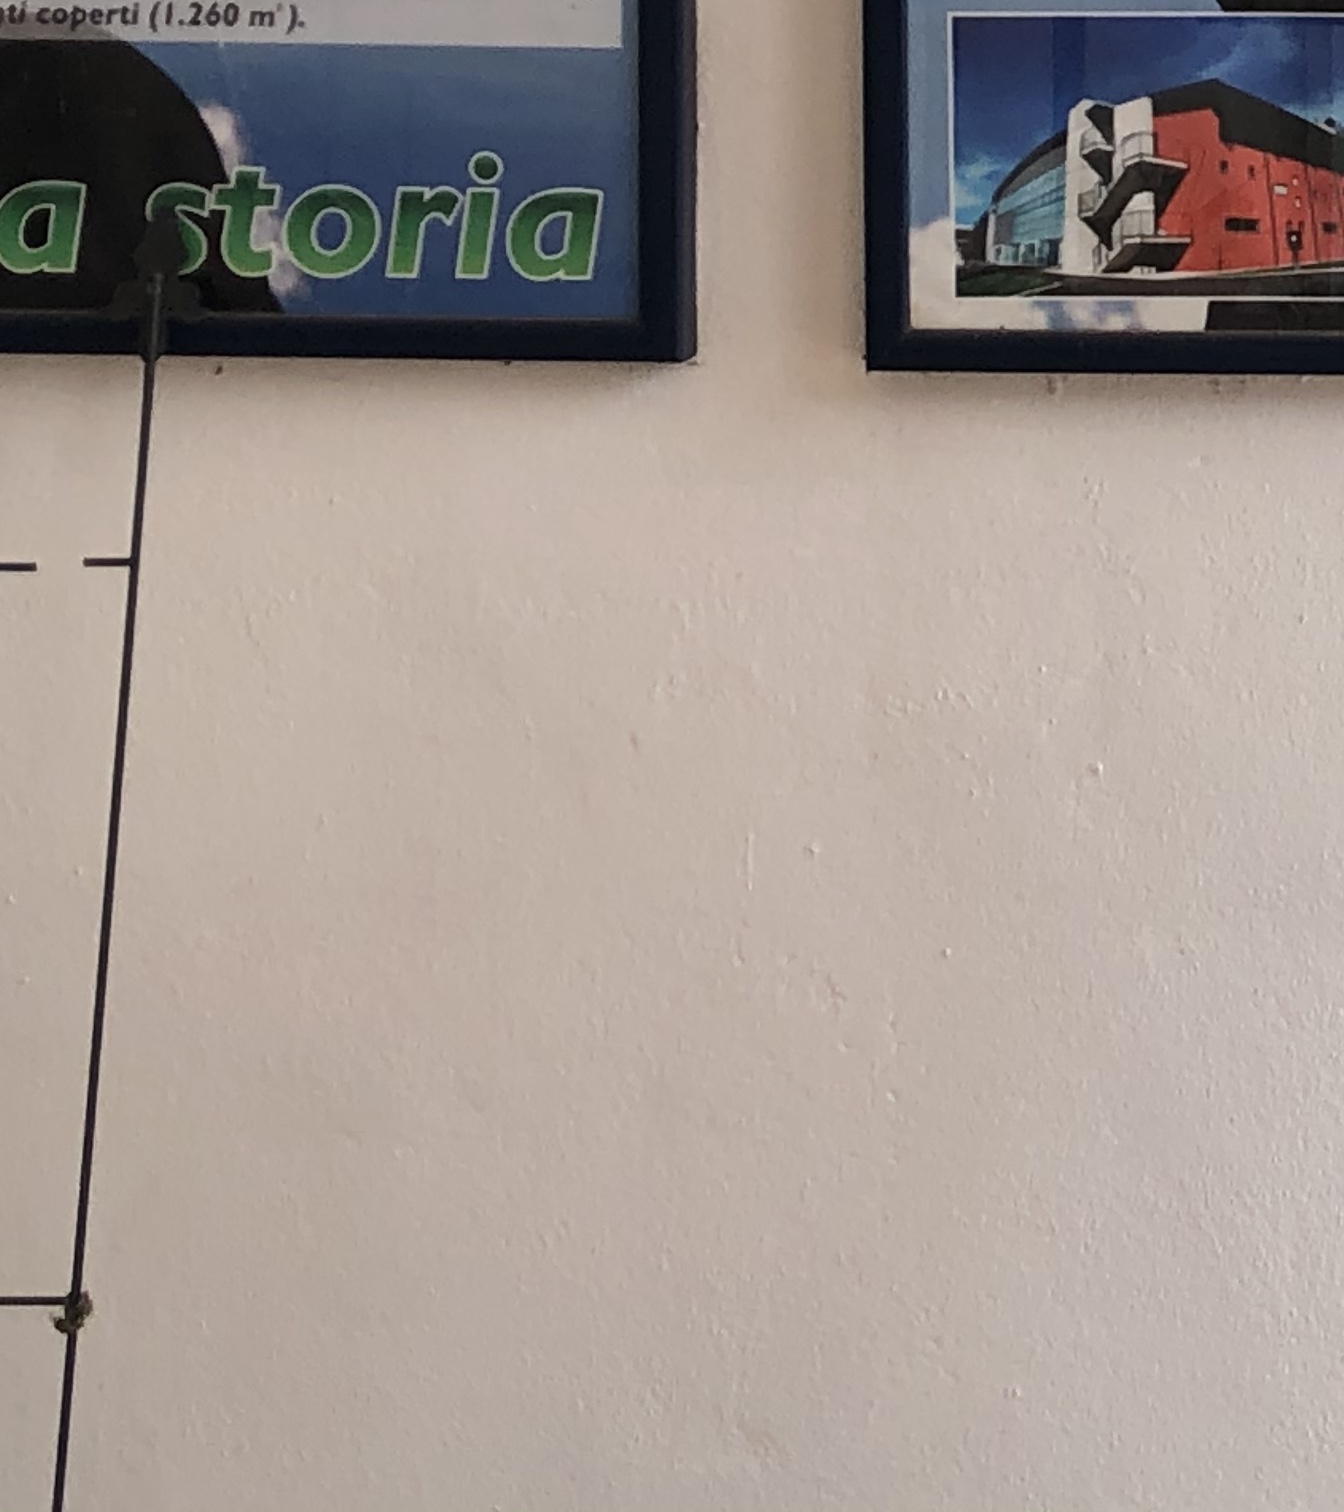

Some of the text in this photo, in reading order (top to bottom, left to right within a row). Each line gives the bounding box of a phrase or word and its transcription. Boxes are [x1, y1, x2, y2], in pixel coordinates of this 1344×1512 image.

[35, 0, 139, 32] coperti
[149, 0, 239, 33] (1.260
[146, 151, 604, 280] storia
